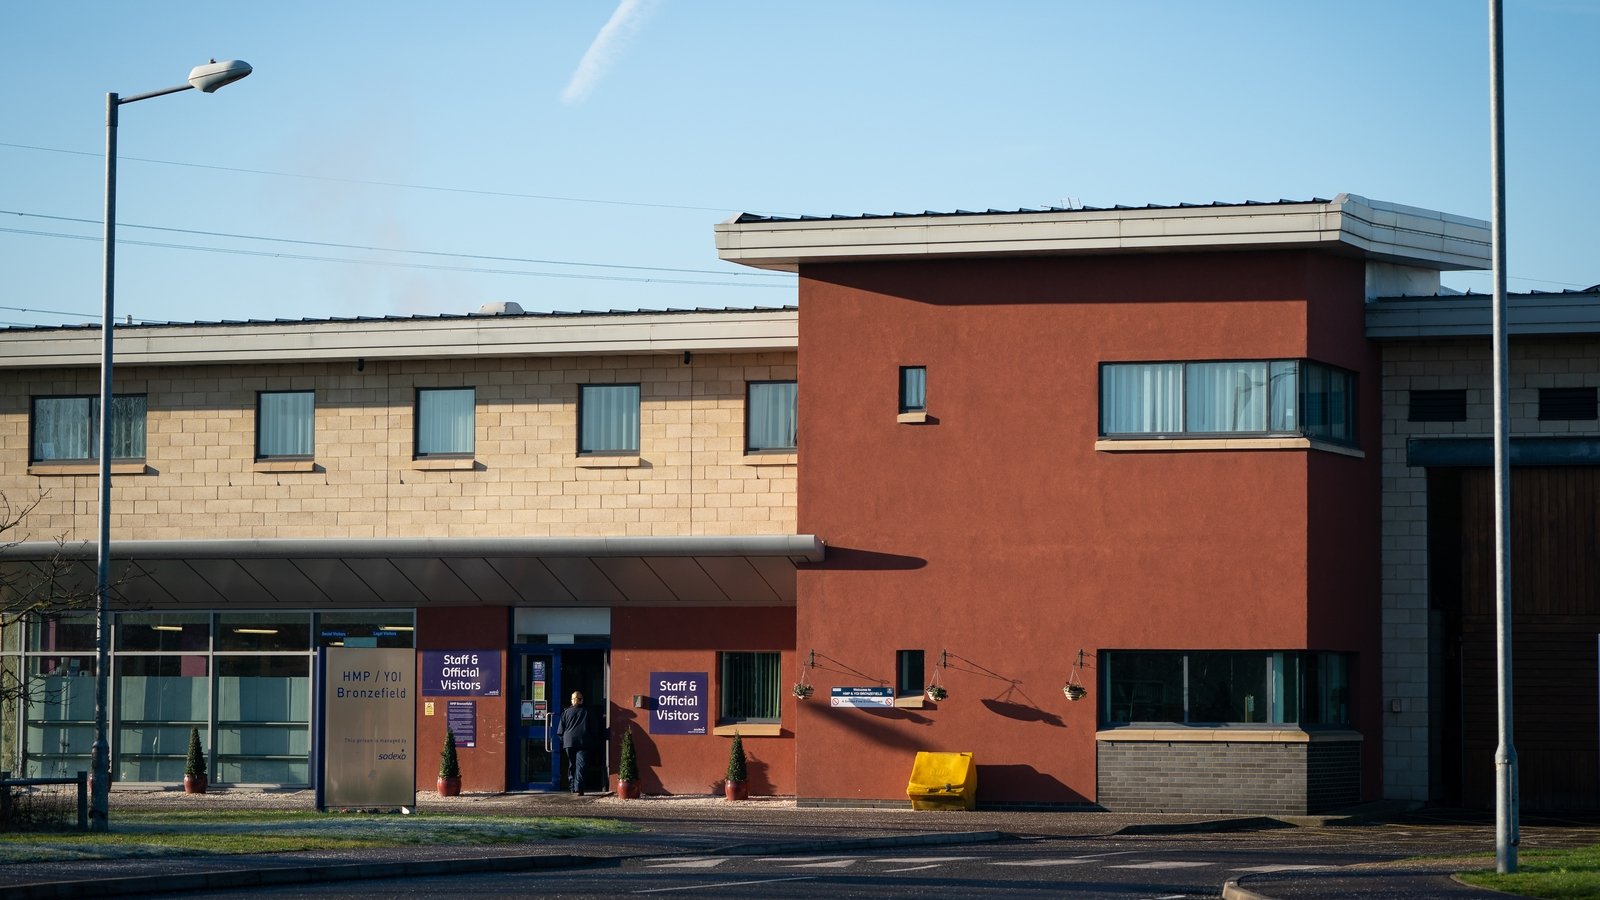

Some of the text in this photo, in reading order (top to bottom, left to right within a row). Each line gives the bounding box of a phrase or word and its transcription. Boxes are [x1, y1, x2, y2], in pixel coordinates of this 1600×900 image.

[444, 654, 478, 664] Staff &
[343, 670, 401, 683] HMP / YOI
[442, 668, 479, 677] Official
[441, 680, 481, 690] Visitors
[660, 681, 697, 691] Staff &
[337, 687, 406, 698] Bronzefield
[658, 695, 697, 706] Official
[656, 710, 699, 720] Visitors
[378, 749, 406, 760] sodexo
